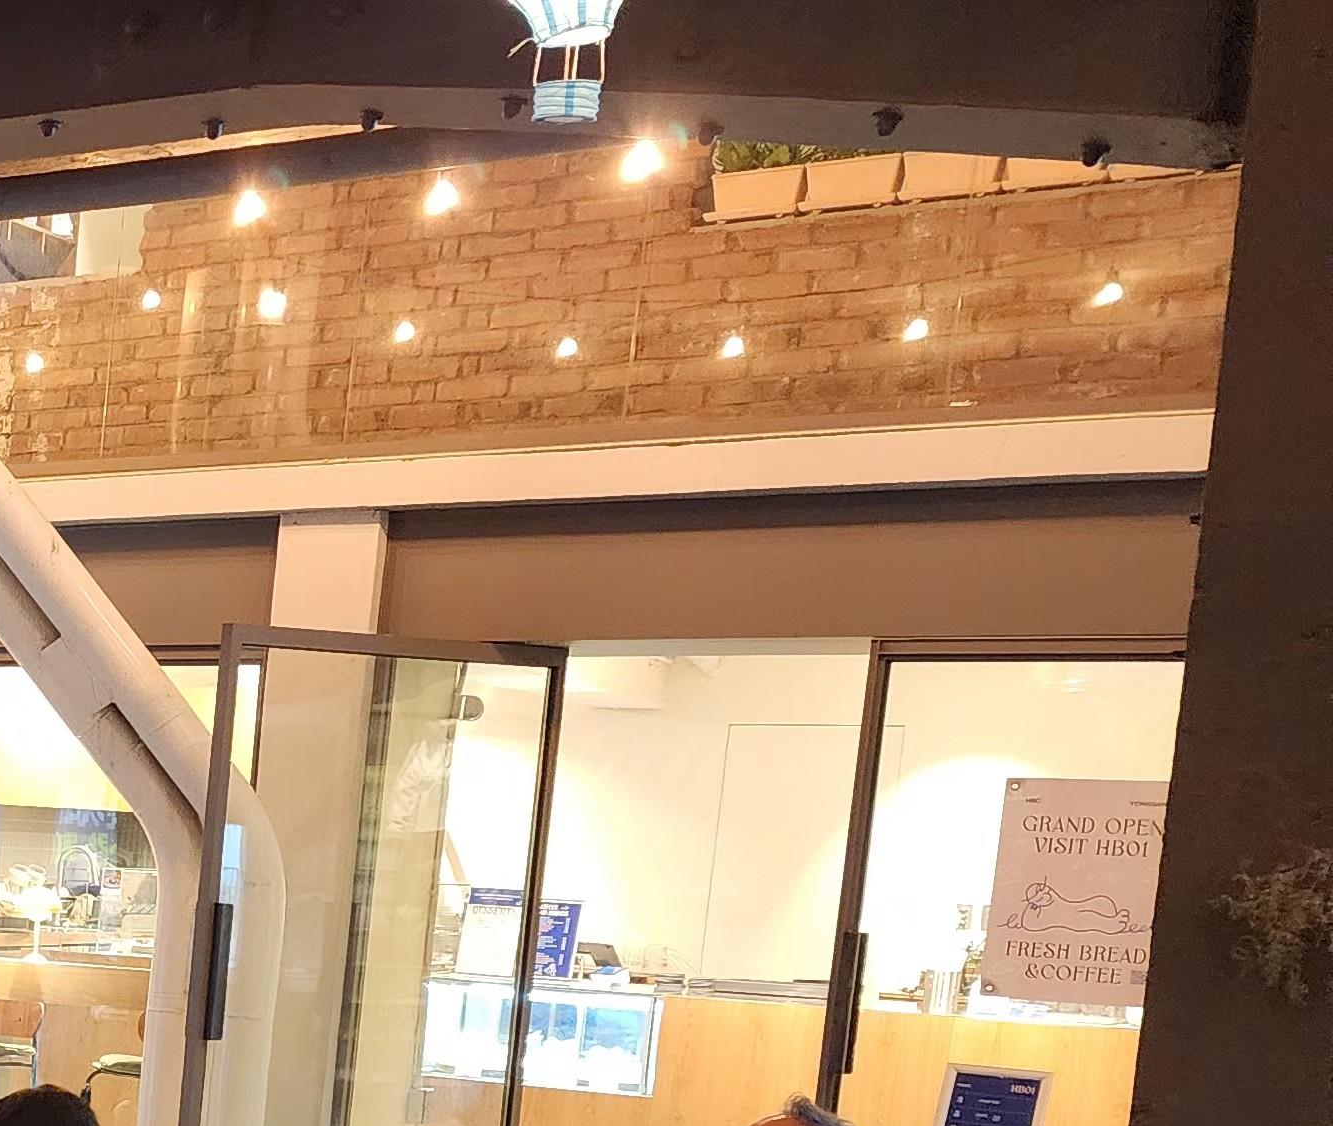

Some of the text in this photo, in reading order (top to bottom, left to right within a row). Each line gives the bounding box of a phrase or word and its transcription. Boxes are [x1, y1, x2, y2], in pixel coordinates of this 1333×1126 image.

[1022, 815, 1164, 836] GRAND OPEN
[1034, 837, 1088, 855] VISIT
[1006, 940, 1147, 965] FRESH BREAD
[1024, 962, 1123, 985] &COFFEE
